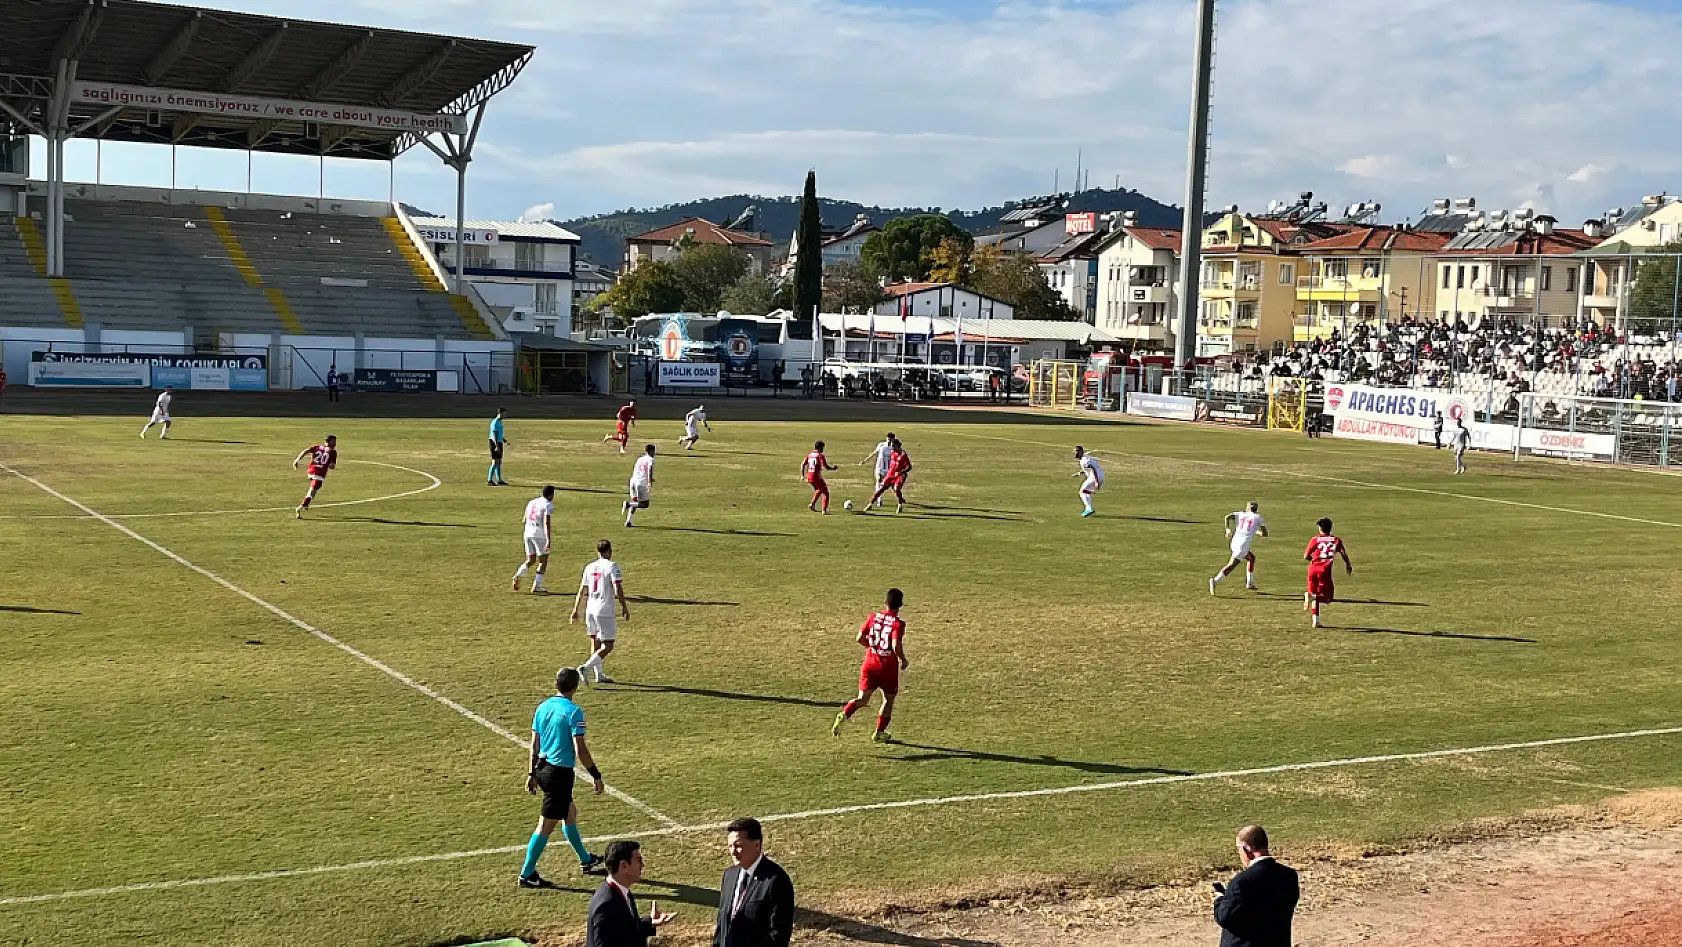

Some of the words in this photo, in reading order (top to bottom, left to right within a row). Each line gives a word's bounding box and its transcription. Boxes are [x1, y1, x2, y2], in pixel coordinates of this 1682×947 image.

[82, 87, 162, 104] sağlığınızı
[166, 94, 259, 112] önemsiyoruz
[274, 105, 294, 116] we
[299, 107, 329, 118] care
[332, 108, 373, 122] about
[376, 115, 407, 126] your
[411, 115, 453, 129] health
[1348, 391, 1416, 416] APACHES
[1418, 398, 1437, 418] 91
[1336, 419, 1376, 437] ABDULLAH
[314, 450, 330, 465] 20
[591, 572, 605, 593] 7
